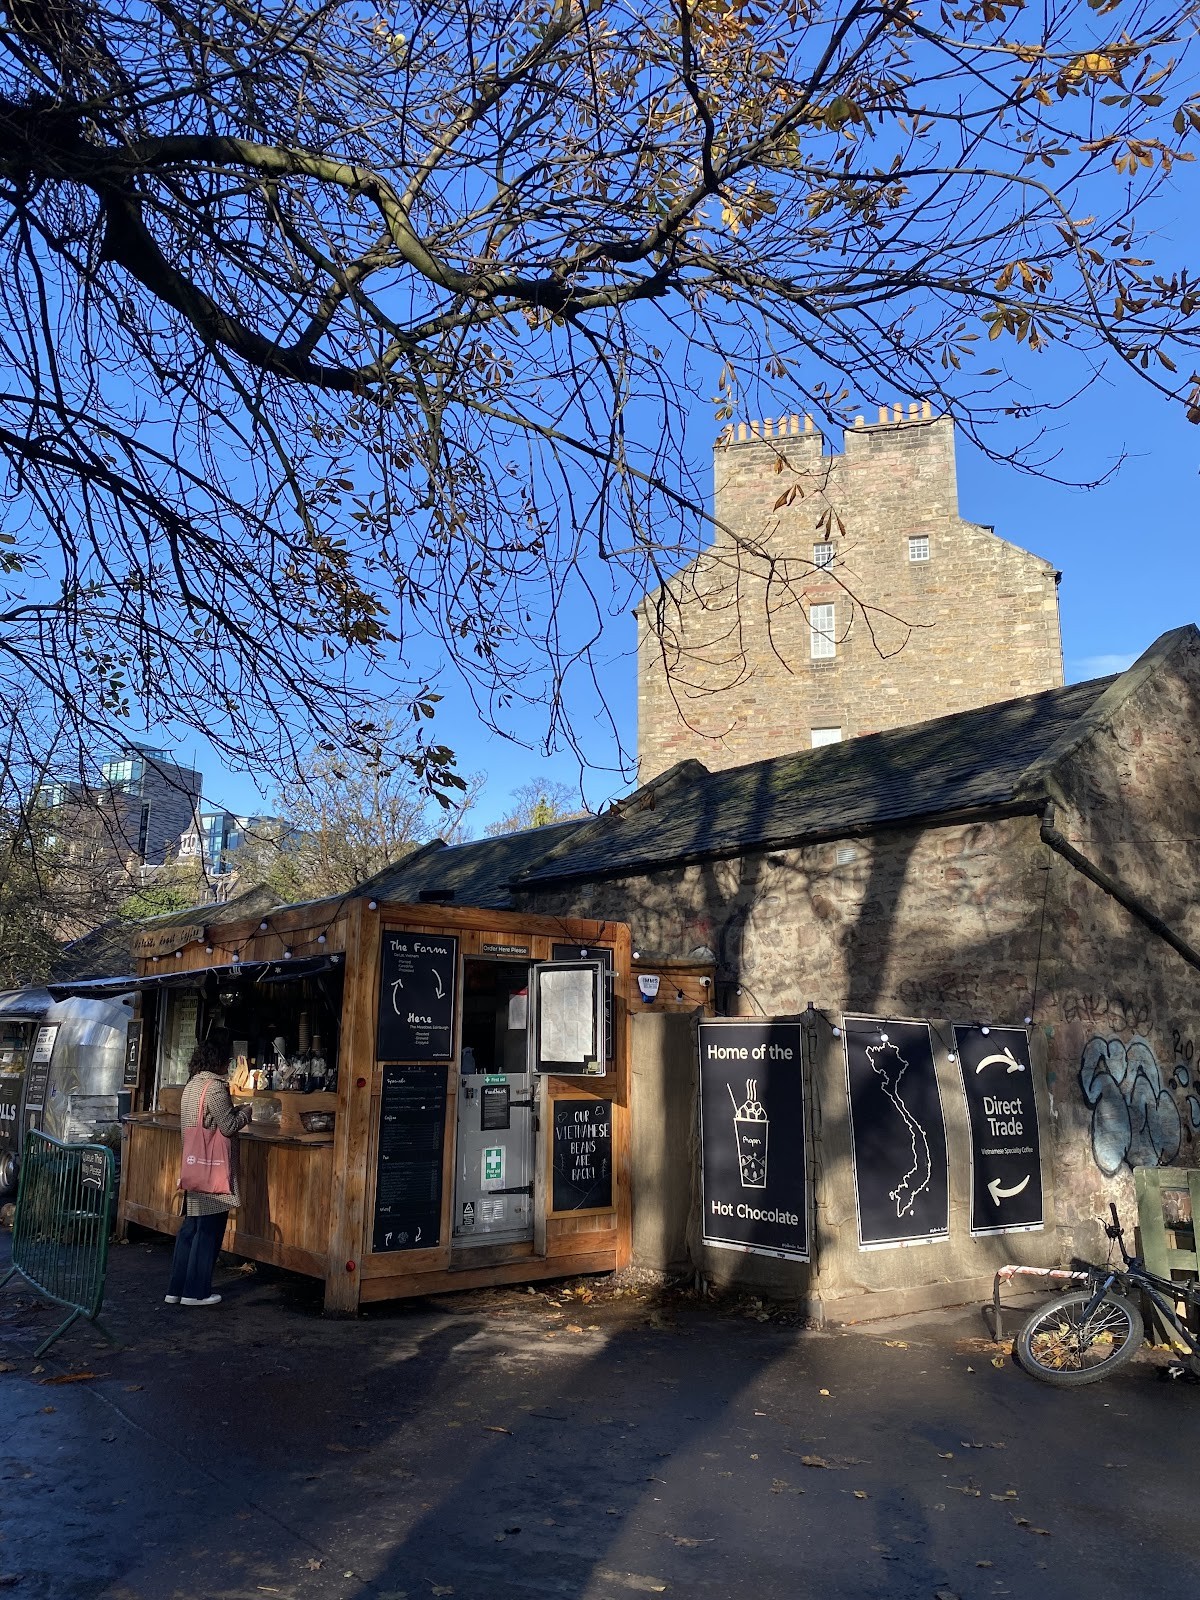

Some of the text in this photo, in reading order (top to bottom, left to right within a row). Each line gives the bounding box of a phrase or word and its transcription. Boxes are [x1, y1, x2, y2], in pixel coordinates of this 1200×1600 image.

[390, 939, 448, 954] The Farm
[407, 1012, 432, 1023] Here
[707, 1043, 793, 1060] Home of the
[983, 1095, 1024, 1115] Direct
[574, 1109, 590, 1123] OUR
[556, 1122, 611, 1141] VIETNAMESE
[987, 1116, 1024, 1136] Trade
[570, 1140, 596, 1155] BEANS
[575, 1154, 591, 1167] ARE
[571, 1166, 595, 1181] BACK!
[711, 1200, 799, 1226] Hot Chocolate
